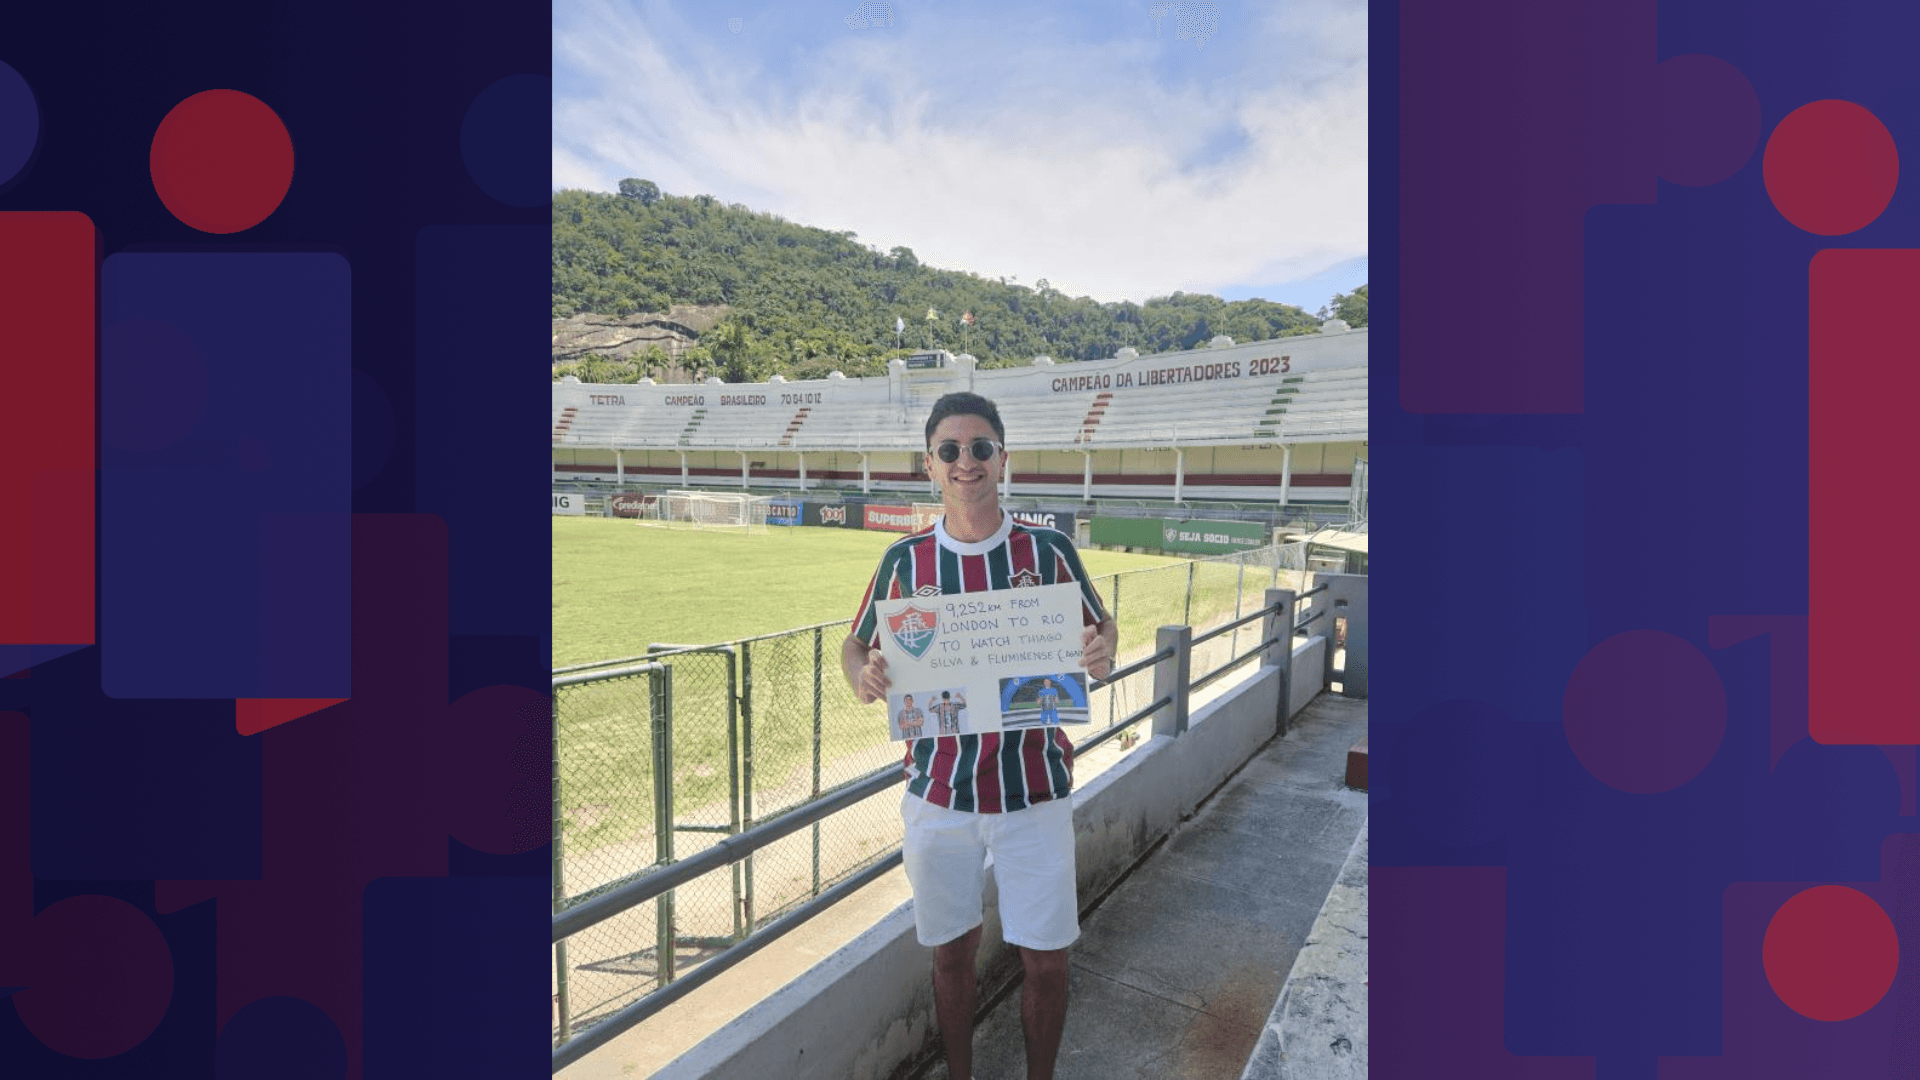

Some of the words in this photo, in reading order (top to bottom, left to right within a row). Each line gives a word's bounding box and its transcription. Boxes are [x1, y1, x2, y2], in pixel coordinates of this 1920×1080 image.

[1116, 372, 1133, 388] DA
[1138, 361, 1241, 386] LIBERTADORES
[1249, 355, 1290, 377] 2023
[589, 394, 626, 406] TETRA
[720, 394, 767, 406] BRASILEIRO
[820, 505, 847, 525] 1001
[867, 510, 925, 527] SUPERBET
[1179, 531, 1202, 542] SEJA
[1010, 598, 1040, 609] FROM
[942, 618, 999, 635] LONDON
[1007, 616, 1029, 629] TO
[1042, 614, 1065, 626] RIO
[939, 640, 961, 653] TO
[970, 634, 1011, 648] WATCH
[1019, 632, 1063, 647] THIAGO
[929, 657, 963, 669] SILVA
[971, 657, 979, 667] &
[987, 652, 1054, 665] FLUMINENSE
